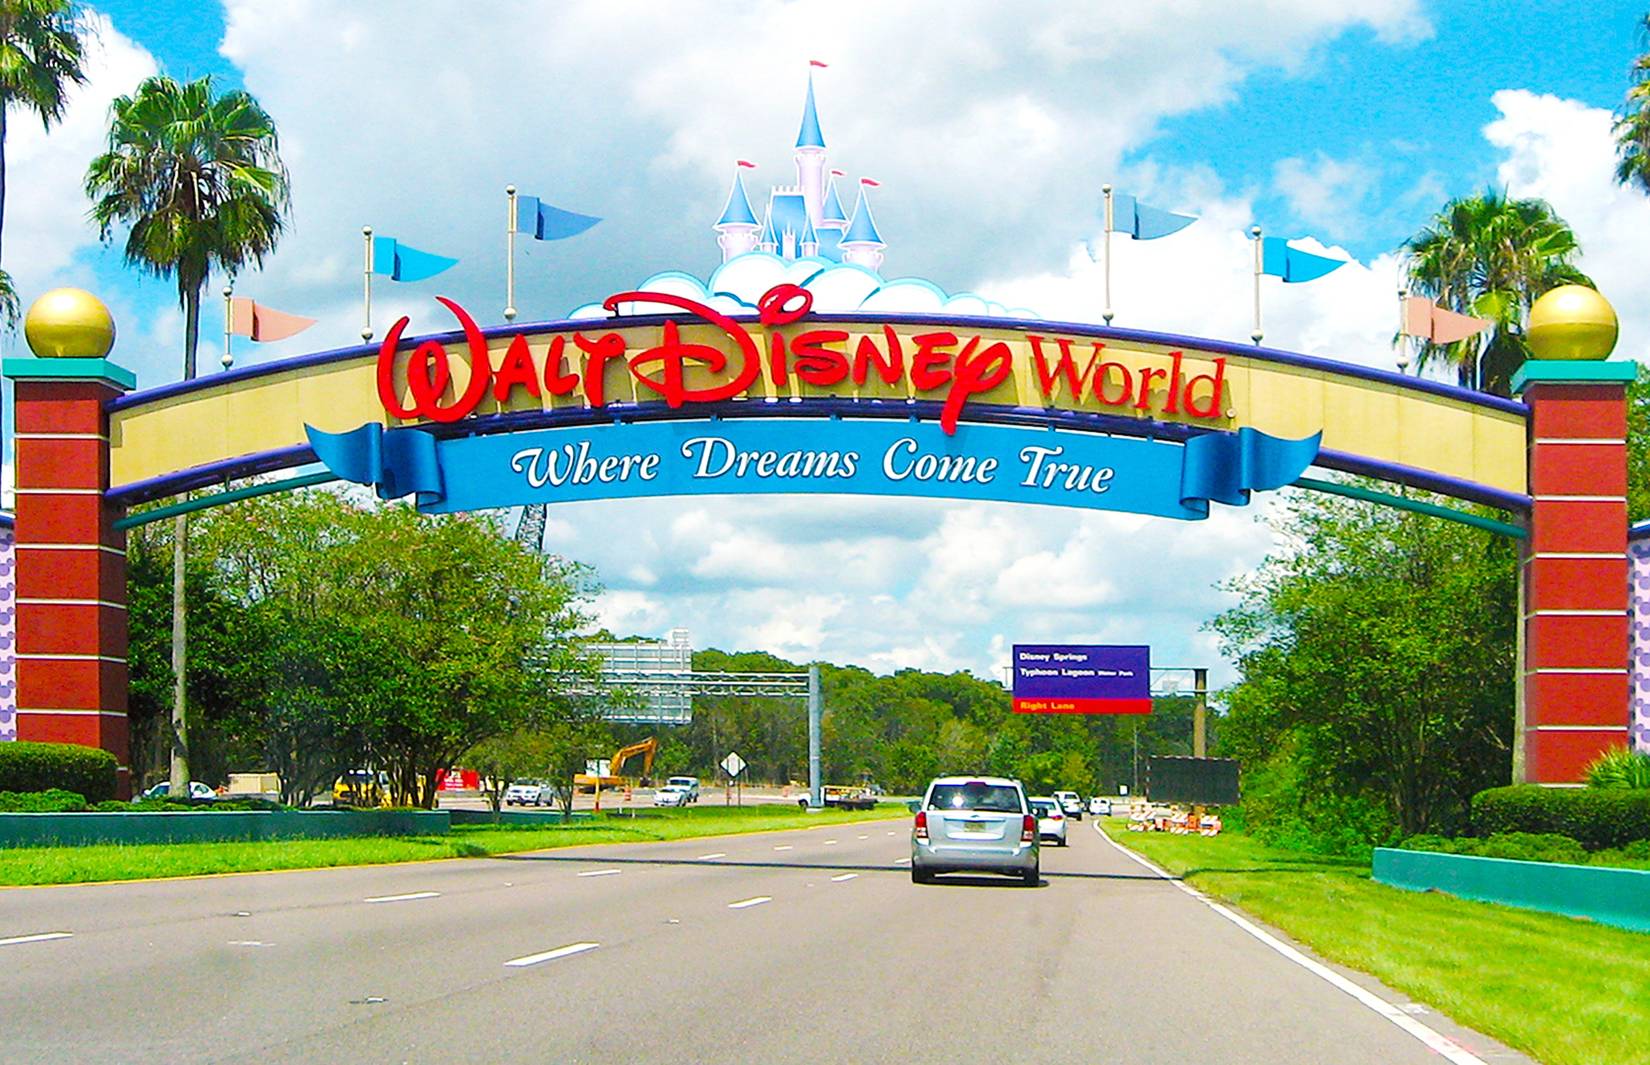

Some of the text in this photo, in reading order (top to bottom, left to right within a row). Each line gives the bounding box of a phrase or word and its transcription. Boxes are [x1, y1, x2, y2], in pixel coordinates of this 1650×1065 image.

[1025, 335, 1227, 419] World
[511, 436, 1115, 492] Where Dreams Come True
[1019, 652, 1088, 662] Disney Springs
[1020, 668, 1059, 677] Typhoon
[1061, 668, 1095, 678] Lagoon
[1020, 702, 1075, 711] Right Lane
